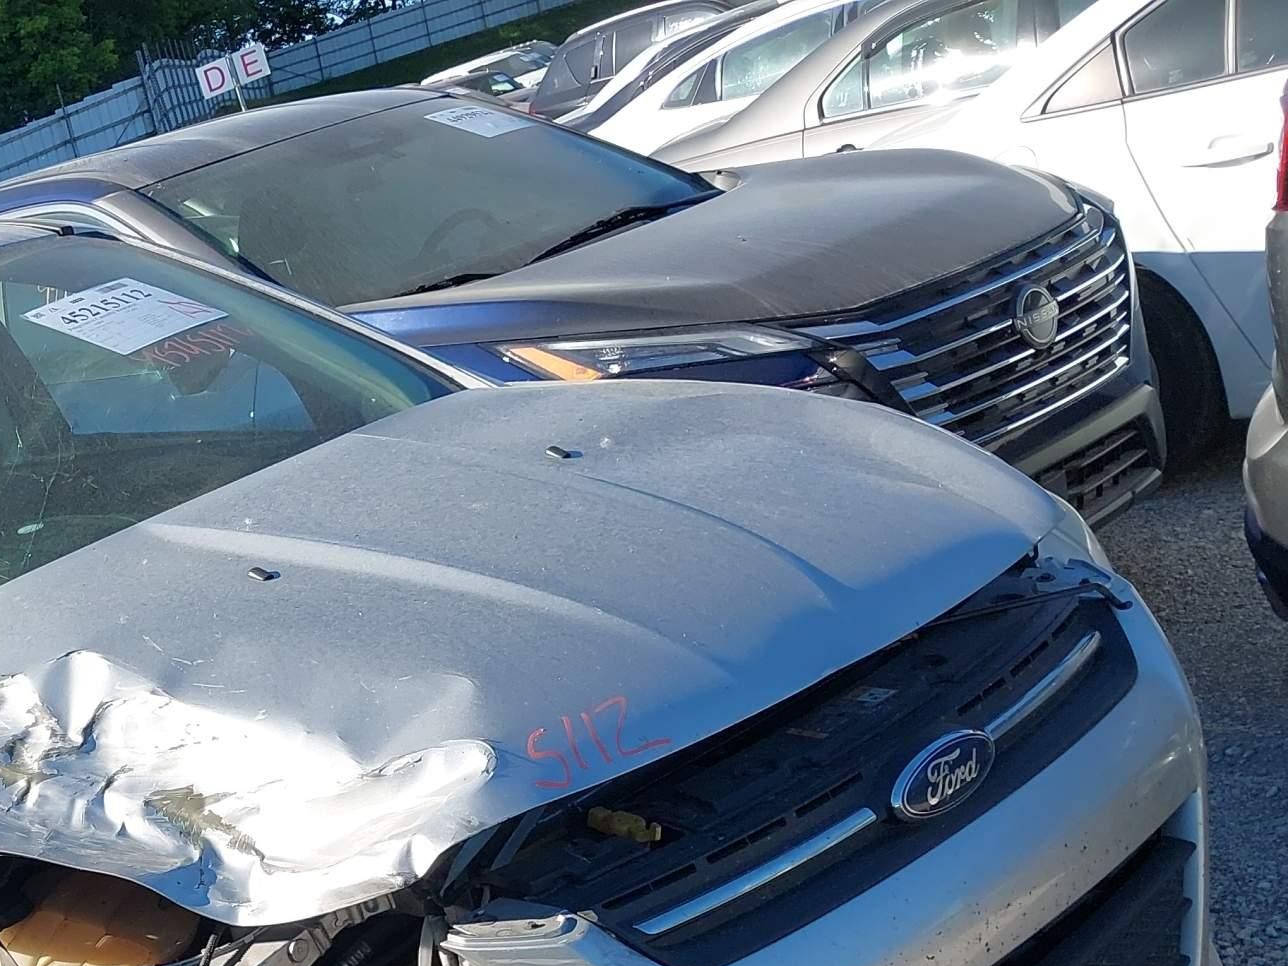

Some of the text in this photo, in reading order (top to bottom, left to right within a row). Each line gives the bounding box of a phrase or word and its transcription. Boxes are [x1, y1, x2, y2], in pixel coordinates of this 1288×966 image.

[203, 49, 263, 93] D E
[60, 289, 153, 325] 45215112
[927, 746, 981, 806] Ford
